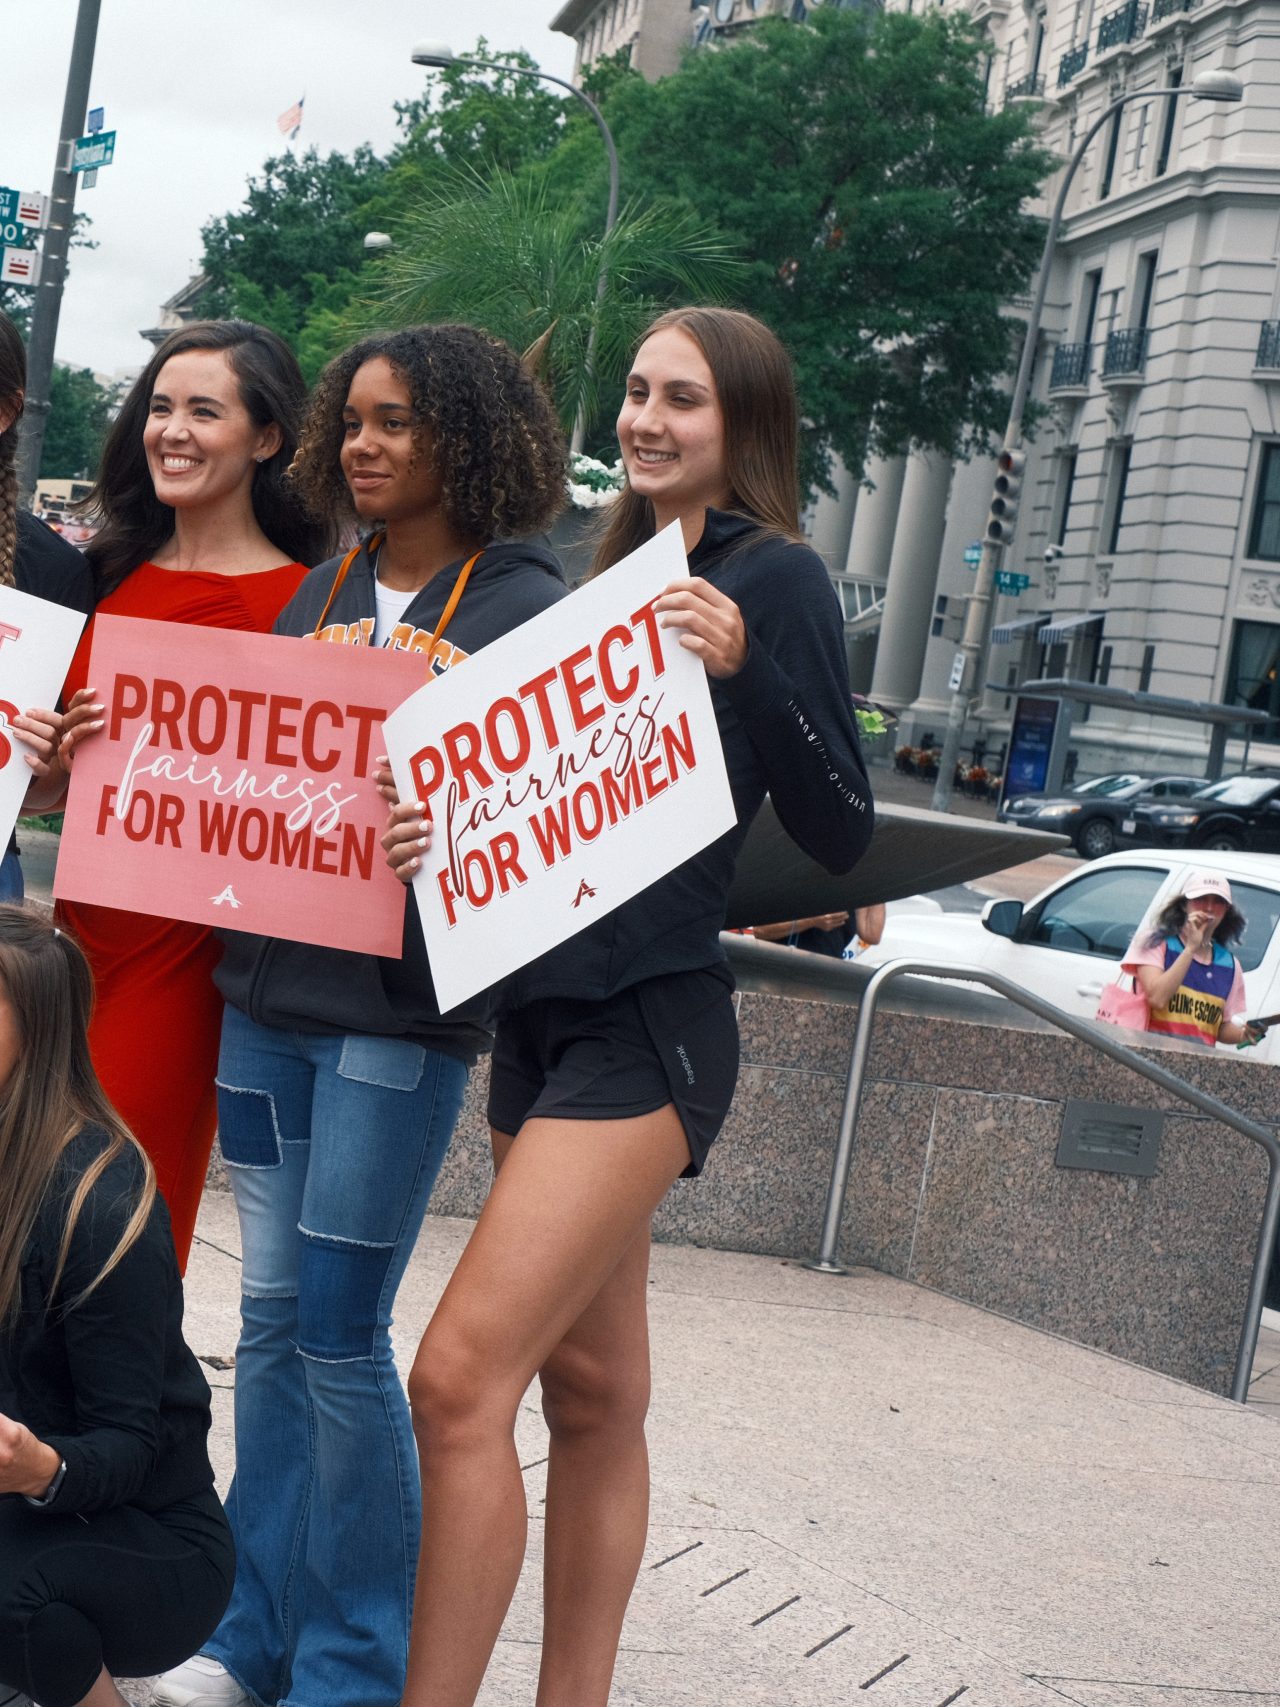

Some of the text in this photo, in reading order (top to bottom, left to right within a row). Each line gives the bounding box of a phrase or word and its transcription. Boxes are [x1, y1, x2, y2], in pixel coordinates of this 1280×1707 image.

[109, 672, 388, 779] PROTECT
[408, 595, 668, 823] PROTECT
[95, 784, 376, 881] FOR WOMEN
[115, 723, 358, 836] fairness
[436, 710, 698, 930] FOR WOMEN
[446, 691, 666, 898] fairness
[675, 1043, 696, 1085] Reebok
